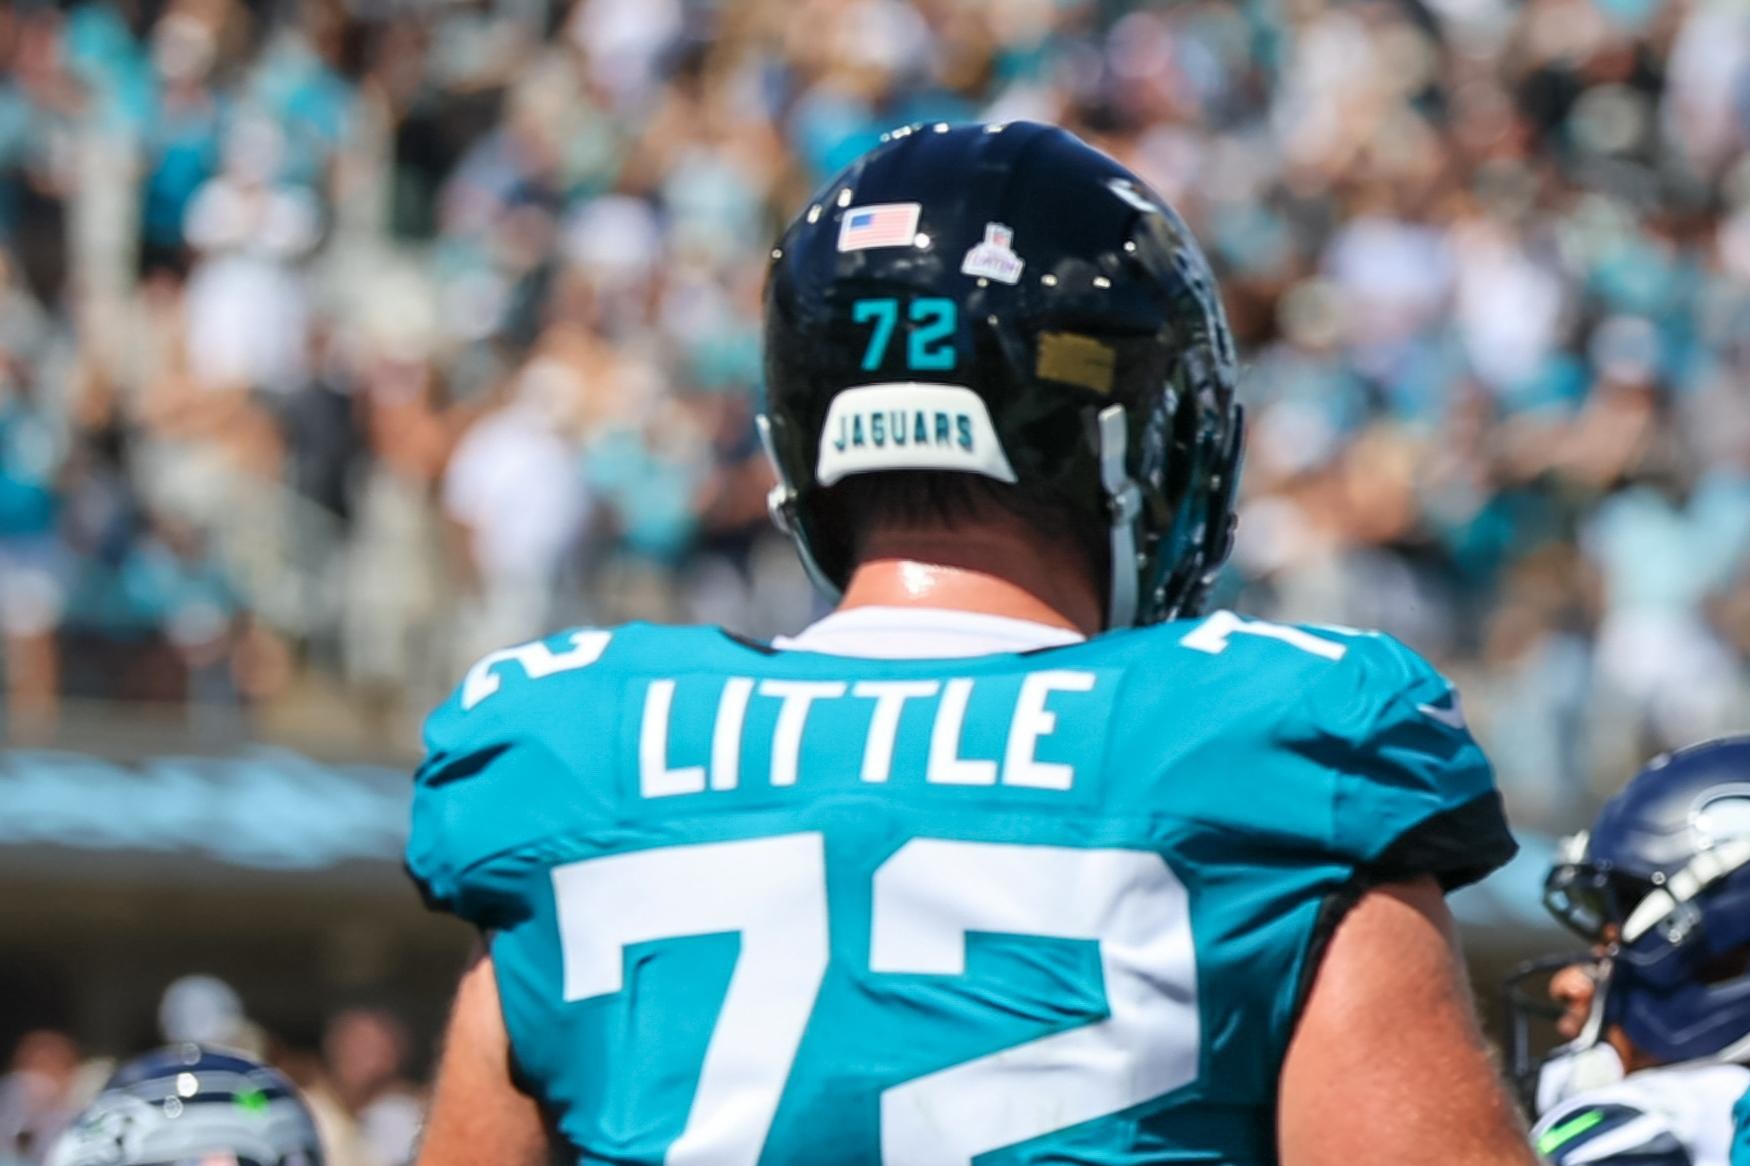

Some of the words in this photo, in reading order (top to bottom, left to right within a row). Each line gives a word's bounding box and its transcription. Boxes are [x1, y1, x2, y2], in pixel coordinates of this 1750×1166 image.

[853, 298, 957, 371] 72
[833, 411, 973, 453] JAGUARS
[639, 670, 1096, 799] LITTLE
